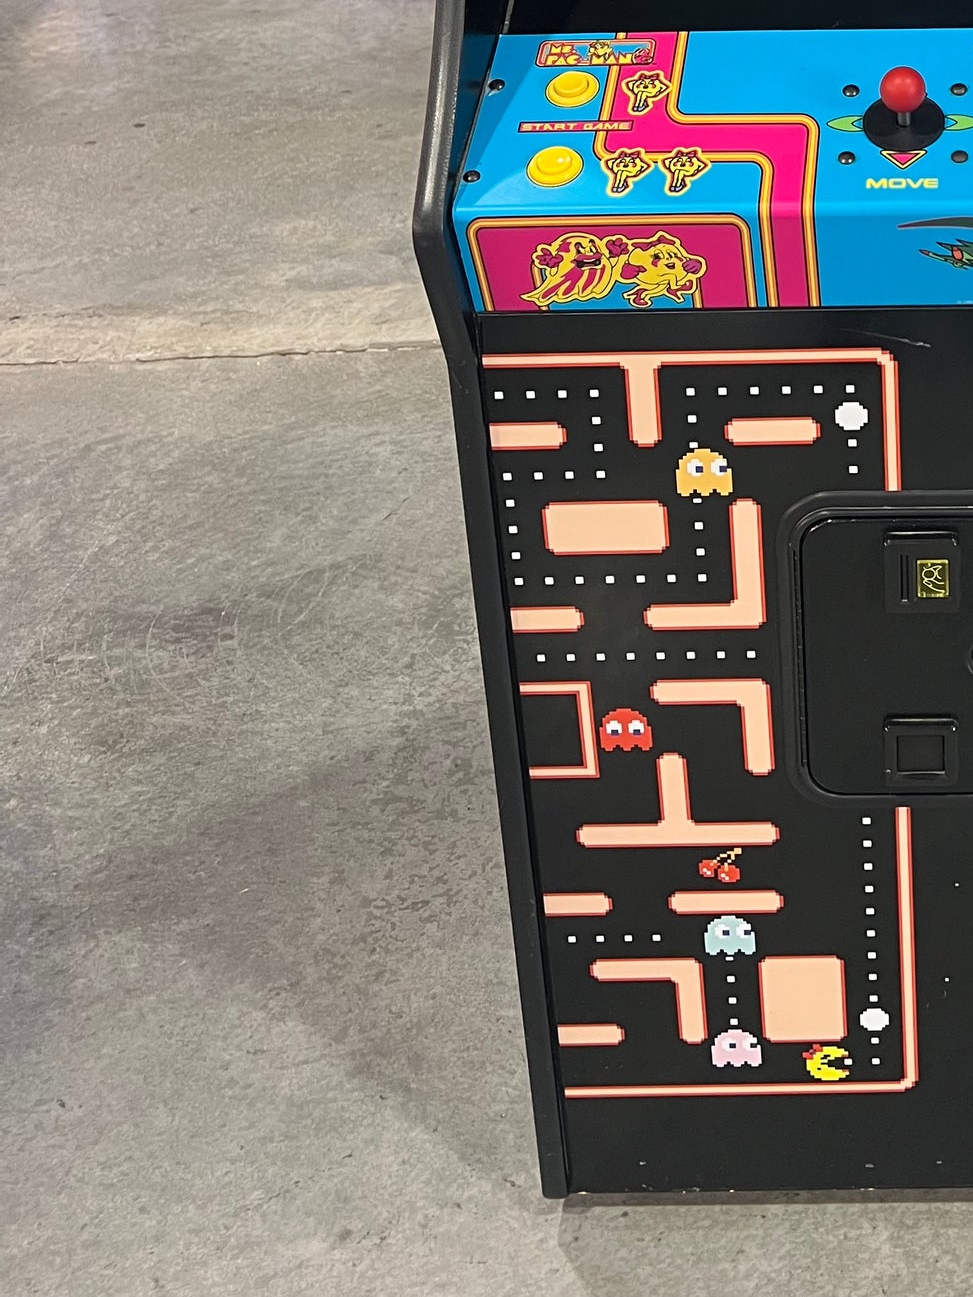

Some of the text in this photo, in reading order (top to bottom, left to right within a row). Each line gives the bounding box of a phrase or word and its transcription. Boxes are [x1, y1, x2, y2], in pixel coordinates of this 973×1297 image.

[546, 53, 634, 66] PAC-MAN
[520, 121, 631, 132] START GAME
[866, 177, 939, 189] MOVE
